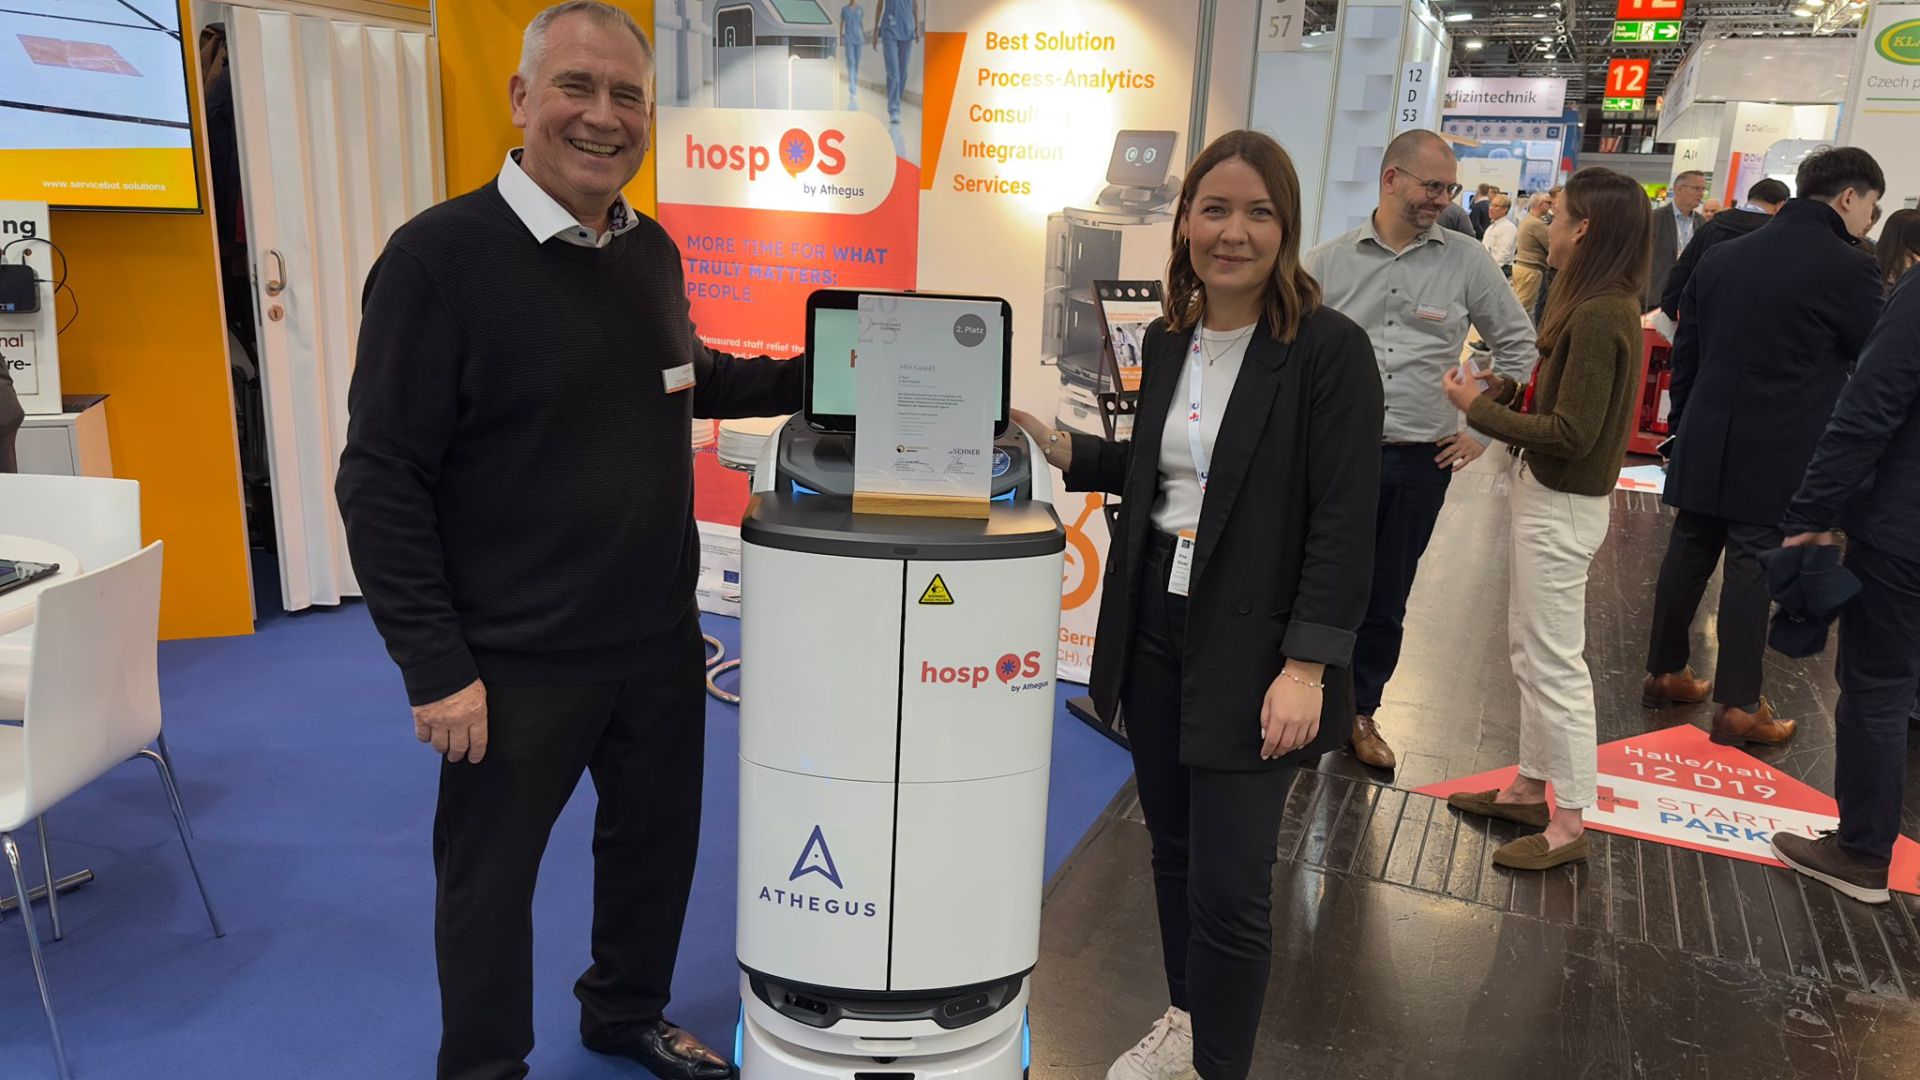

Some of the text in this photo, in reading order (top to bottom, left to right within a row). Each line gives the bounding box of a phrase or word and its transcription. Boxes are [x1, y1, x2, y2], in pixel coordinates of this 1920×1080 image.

[1267, 15, 1292, 38] 57
[985, 31, 1116, 51] Best Solution
[977, 67, 1156, 93] Process-Analytics
[1408, 68, 1423, 82] 12
[1613, 65, 1644, 91] 12
[1867, 75, 1909, 88] Czech
[1407, 89, 1417, 102] D
[1402, 109, 1417, 122] 53
[962, 140, 1063, 163] Integration
[803, 183, 865, 199] by Athegus
[953, 174, 1031, 195] Services
[687, 235, 888, 264] MORE TIME FOR WHAT
[687, 258, 839, 286] TRULY MATTERS:
[687, 282, 756, 302] PEOPLE.
[955, 325, 985, 334] 2. Platz
[699, 334, 741, 347] Measured
[743, 340, 764, 349] staff
[766, 342, 789, 352] relief
[1010, 680, 1049, 693] by Athegus
[1624, 745, 1776, 782] Halle/hall
[1629, 762, 1777, 800] 12 D19
[759, 886, 877, 917] ATHEGUS
